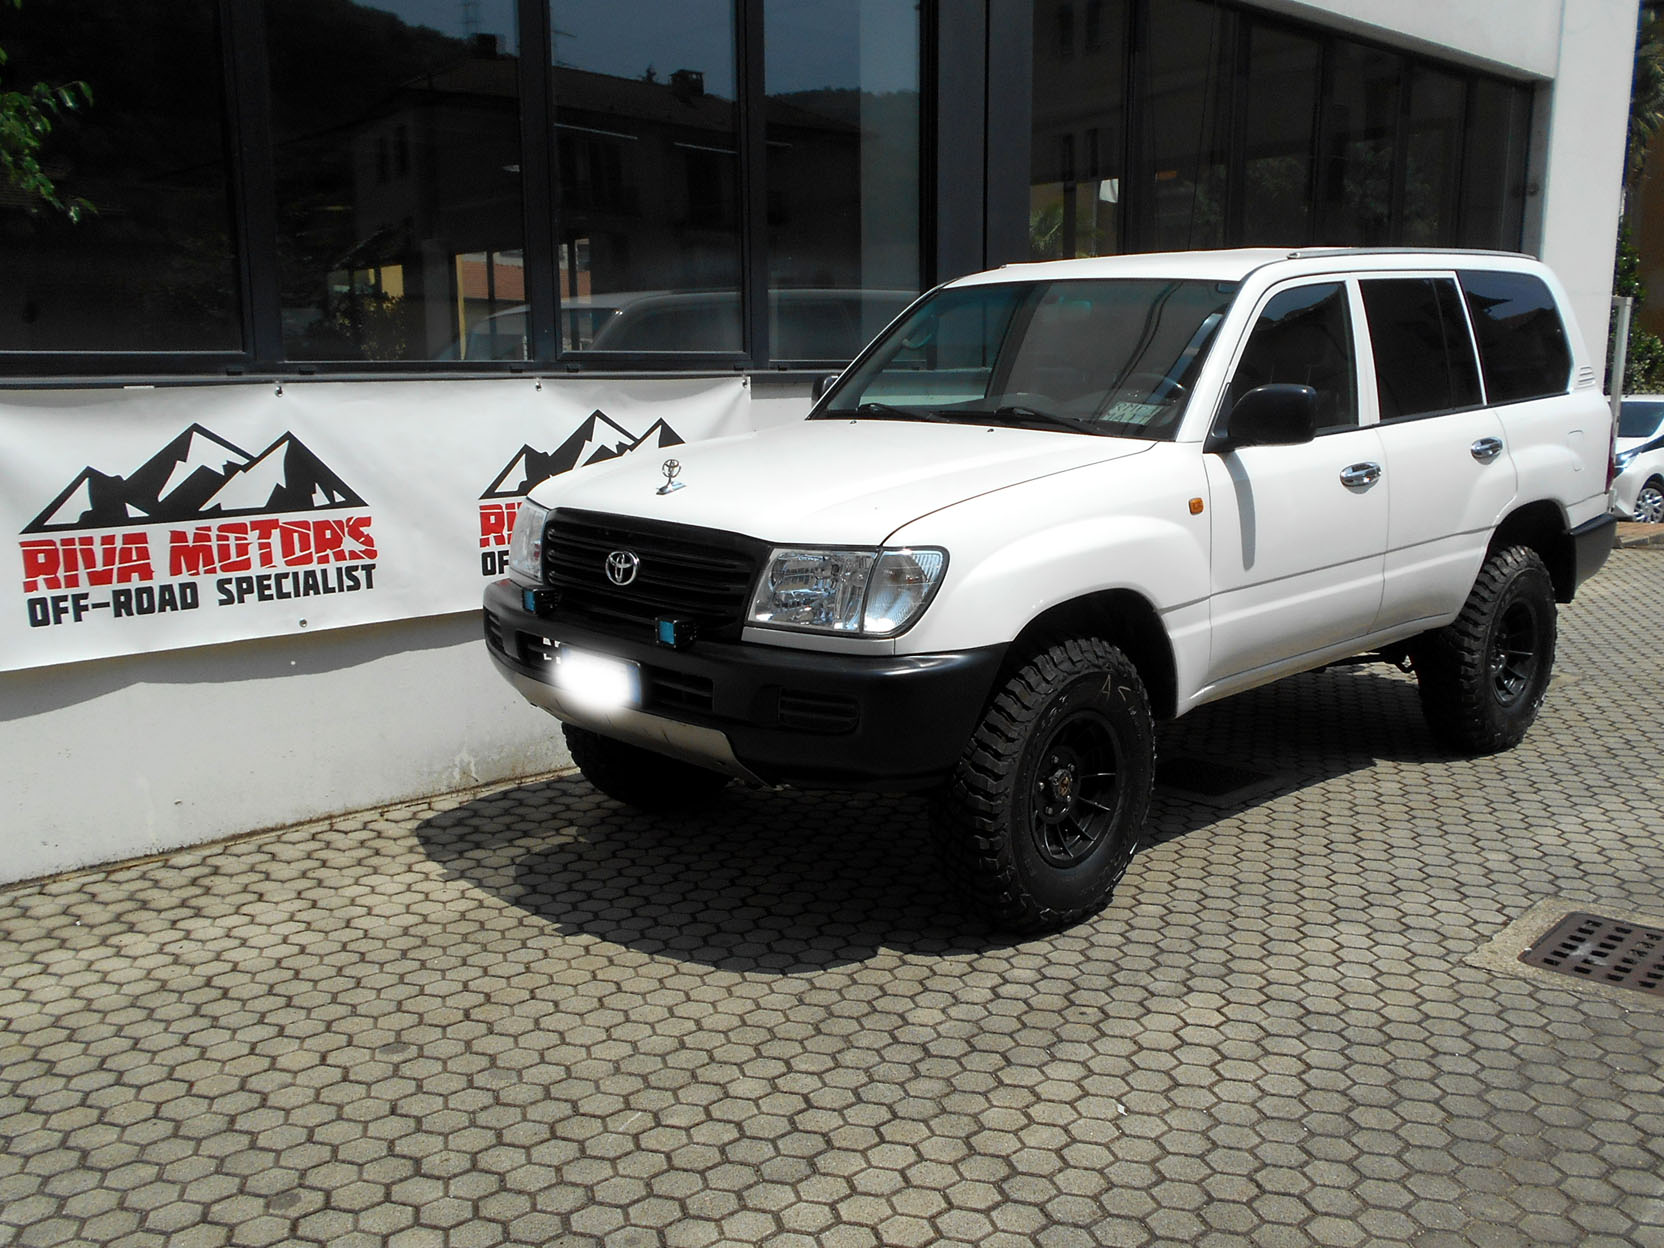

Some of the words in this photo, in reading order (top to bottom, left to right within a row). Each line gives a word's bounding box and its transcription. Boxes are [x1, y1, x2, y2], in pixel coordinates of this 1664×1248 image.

[19, 532, 155, 593] RIVA
[169, 516, 378, 577] MOTORS
[26, 581, 199, 628] OFF-ROAD
[216, 563, 376, 606] SPECIALIST
